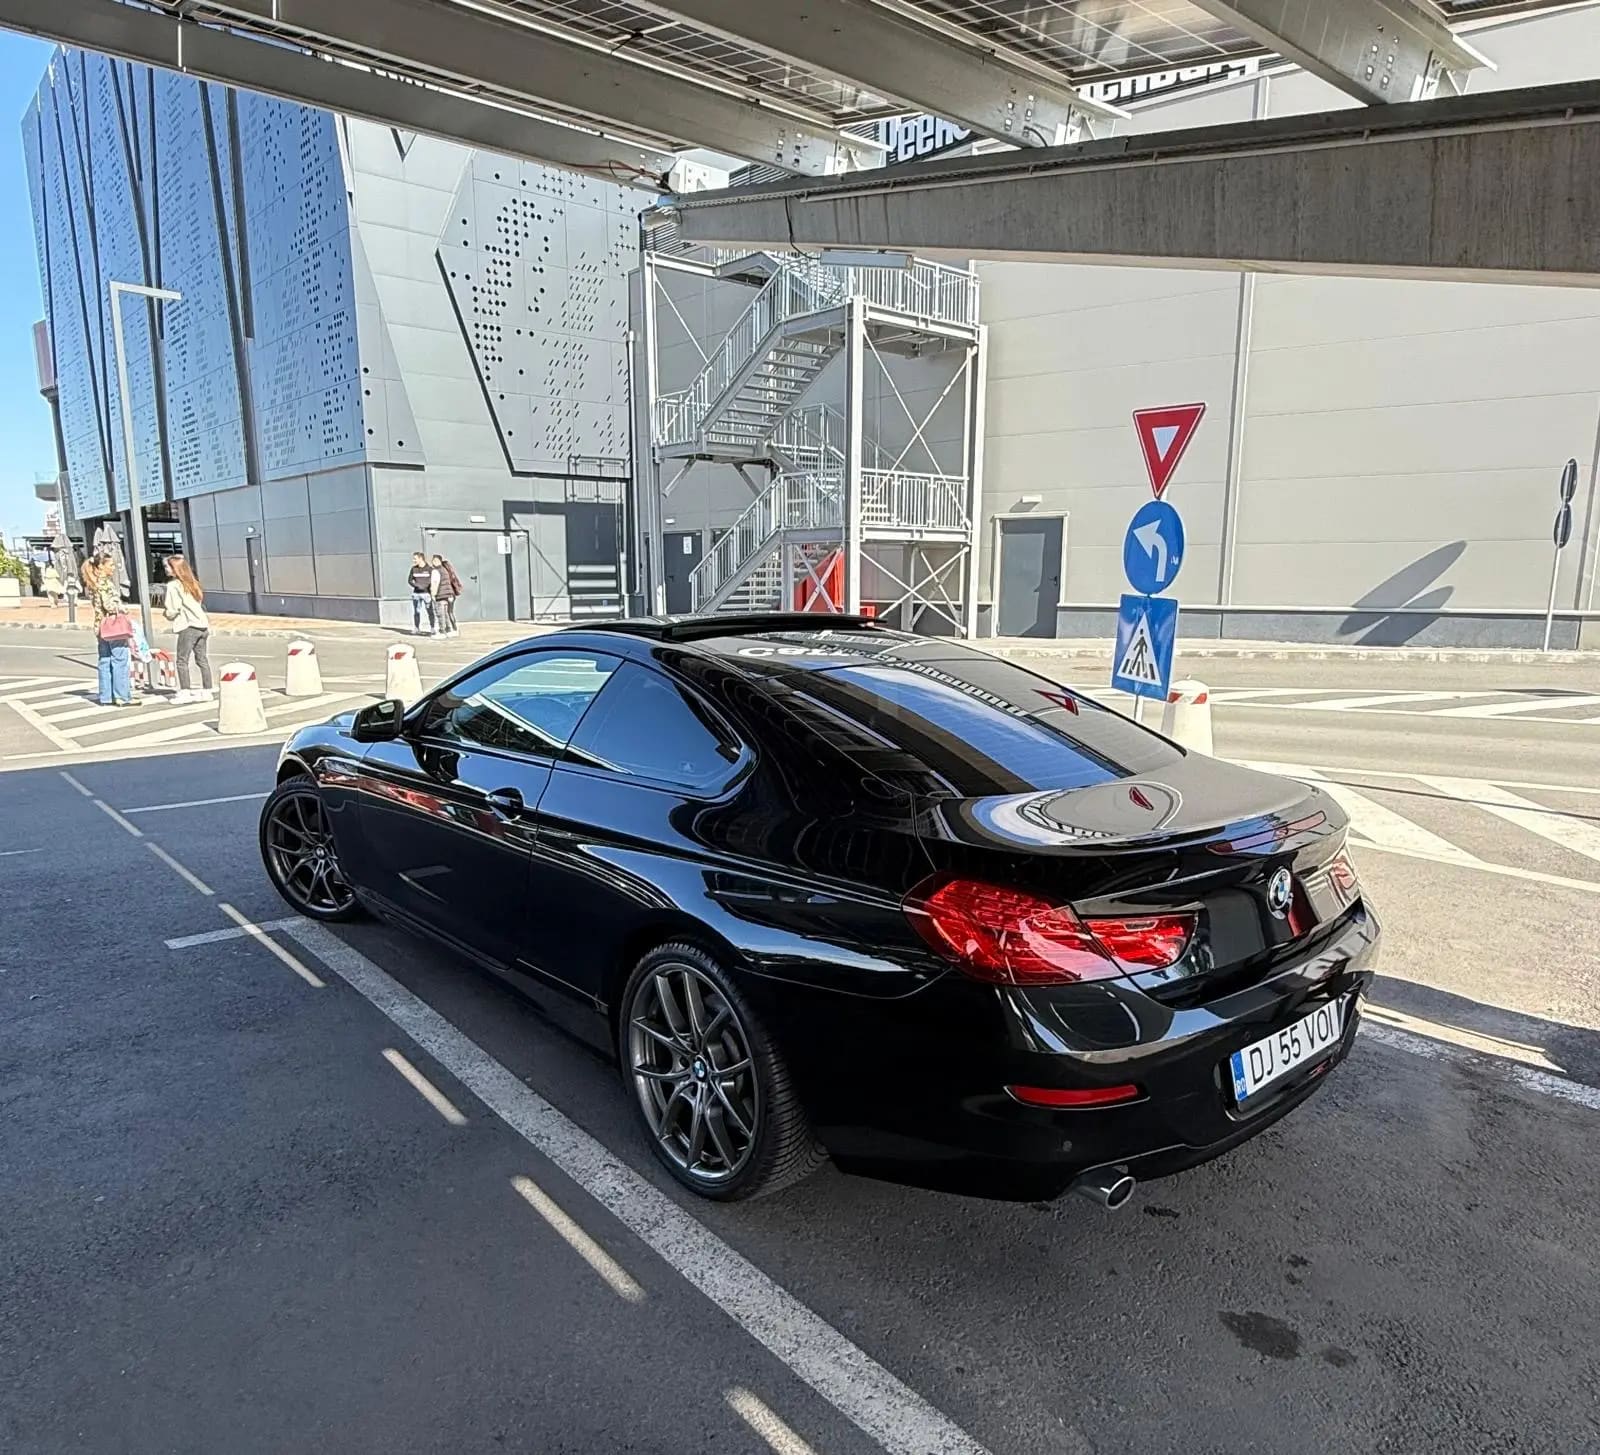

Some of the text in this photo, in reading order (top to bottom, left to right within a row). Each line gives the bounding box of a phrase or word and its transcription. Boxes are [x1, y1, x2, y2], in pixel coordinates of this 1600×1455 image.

[1249, 1005, 1334, 1086] DJ 55 VOI
